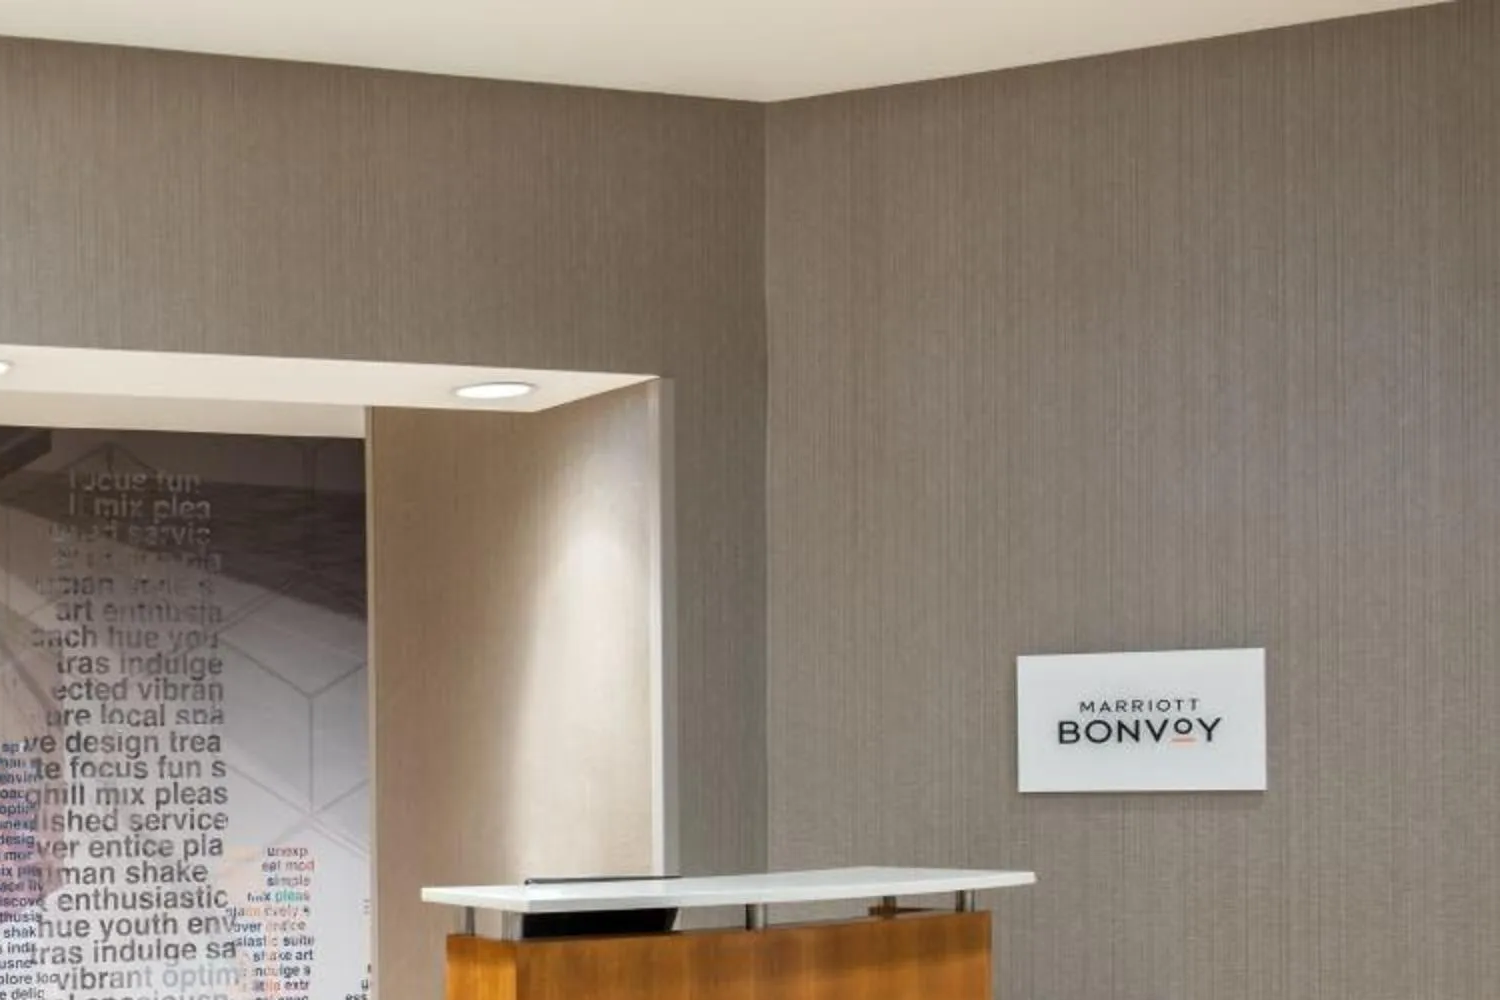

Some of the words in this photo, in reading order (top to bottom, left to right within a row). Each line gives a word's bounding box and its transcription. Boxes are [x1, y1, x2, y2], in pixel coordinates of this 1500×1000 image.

[108, 625, 159, 648] hue
[120, 652, 223, 680] indulge
[137, 677, 224, 701] vibran
[99, 703, 165, 726] local
[1079, 698, 1198, 713] MARRIOTT
[1058, 717, 1222, 744] BONVOY
[65, 731, 159, 760] design
[169, 732, 221, 752] trea
[70, 755, 149, 779] focus
[157, 755, 201, 779] fun
[211, 760, 227, 778] s
[95, 786, 145, 805] mix
[155, 782, 229, 811] pleas
[129, 808, 229, 831] service
[88, 834, 174, 858] entice
[183, 833, 223, 862] pla
[124, 860, 209, 885] shake
[57, 885, 229, 914] enthusiastic
[37, 916, 91, 939] hue
[100, 911, 178, 943] youth
[93, 938, 197, 967] indulge
[205, 941, 236, 960] sa
[295, 948, 314, 960] art
[56, 966, 154, 991] vibrant
[161, 962, 239, 992] optim
